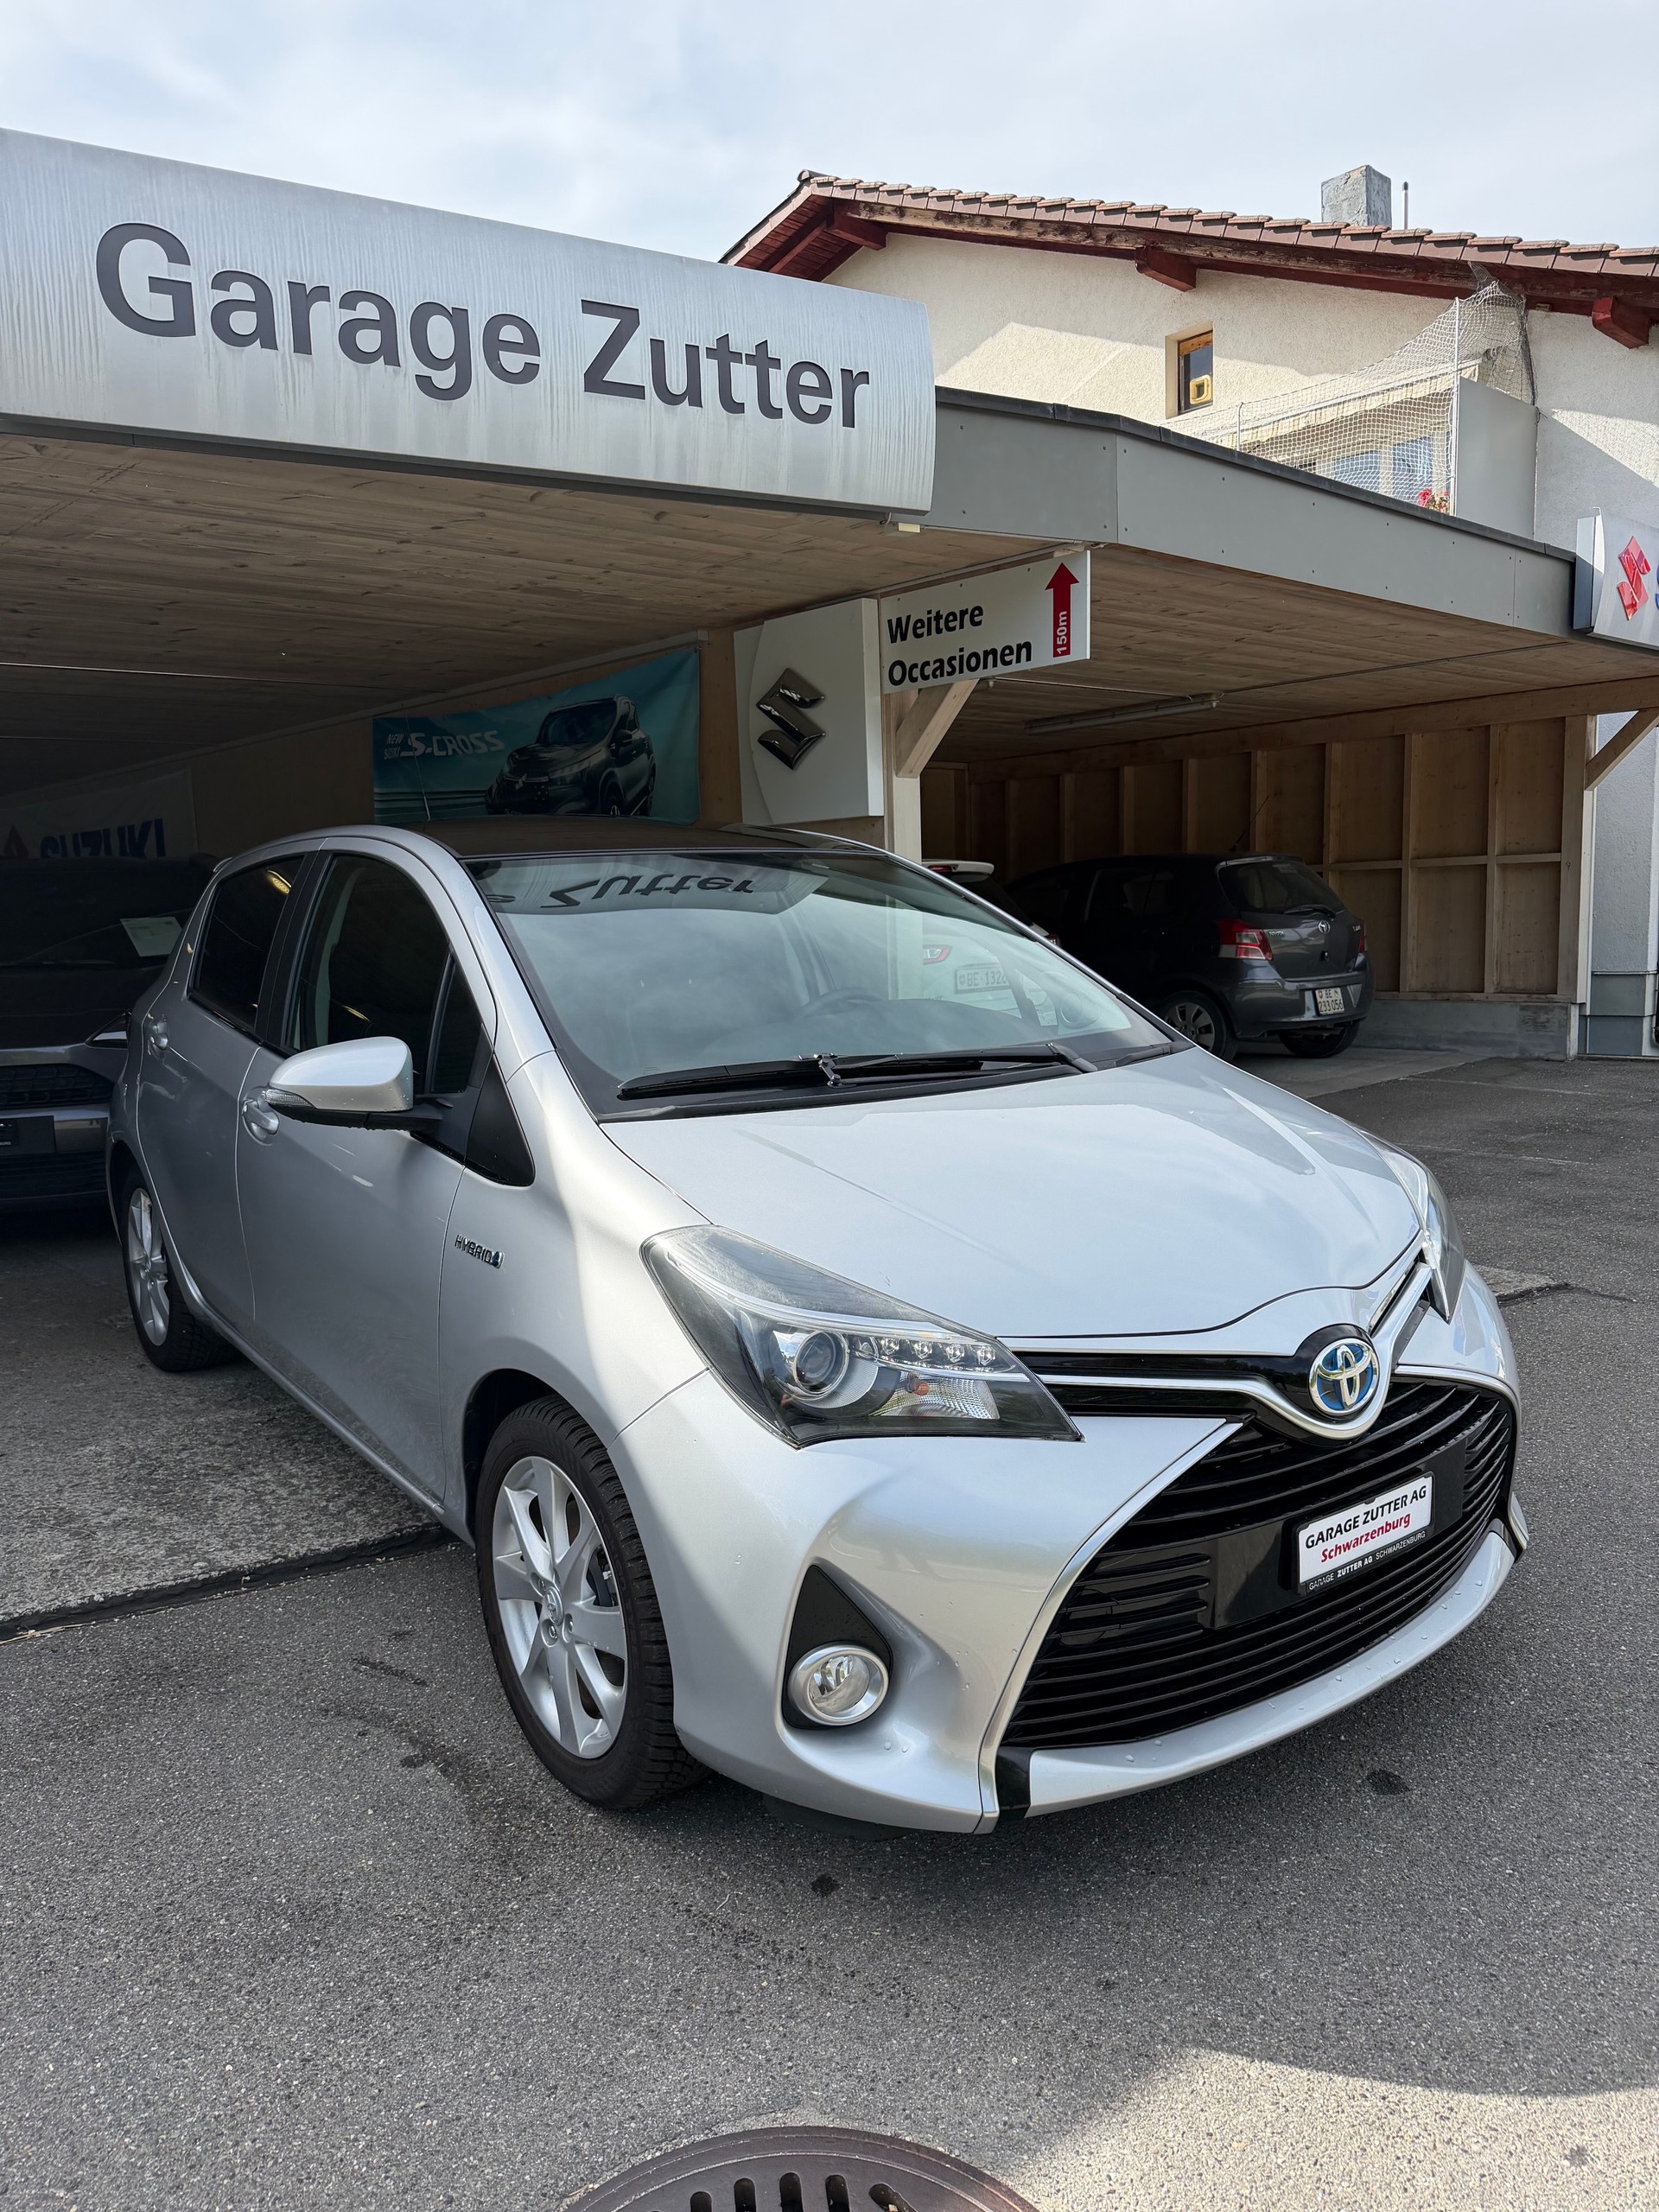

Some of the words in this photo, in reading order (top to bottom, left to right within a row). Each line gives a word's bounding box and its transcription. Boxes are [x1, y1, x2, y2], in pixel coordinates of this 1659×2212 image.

[96, 222, 540, 400] Garage
[581, 299, 869, 429] Zutter
[887, 606, 983, 644] Weitere
[1056, 611, 1067, 654] 150m
[888, 640, 1032, 686] Occasionen
[386, 734, 405, 745] NEW
[400, 730, 505, 757] S-CROSS
[454, 1234, 493, 1264] HYBRID
[1306, 1516, 1360, 1549] GARAGE
[1363, 1495, 1408, 1525] ZUTTER
[1409, 1485, 1427, 1504] AG
[1321, 1513, 1410, 1563] Schwarzenburg
[1308, 1573, 1334, 1590] GARAGE
[1337, 1560, 1363, 1577] ZUTTER
[1363, 1555, 1373, 1566] AG
[1376, 1531, 1426, 1560] SCHWARZENBURG
